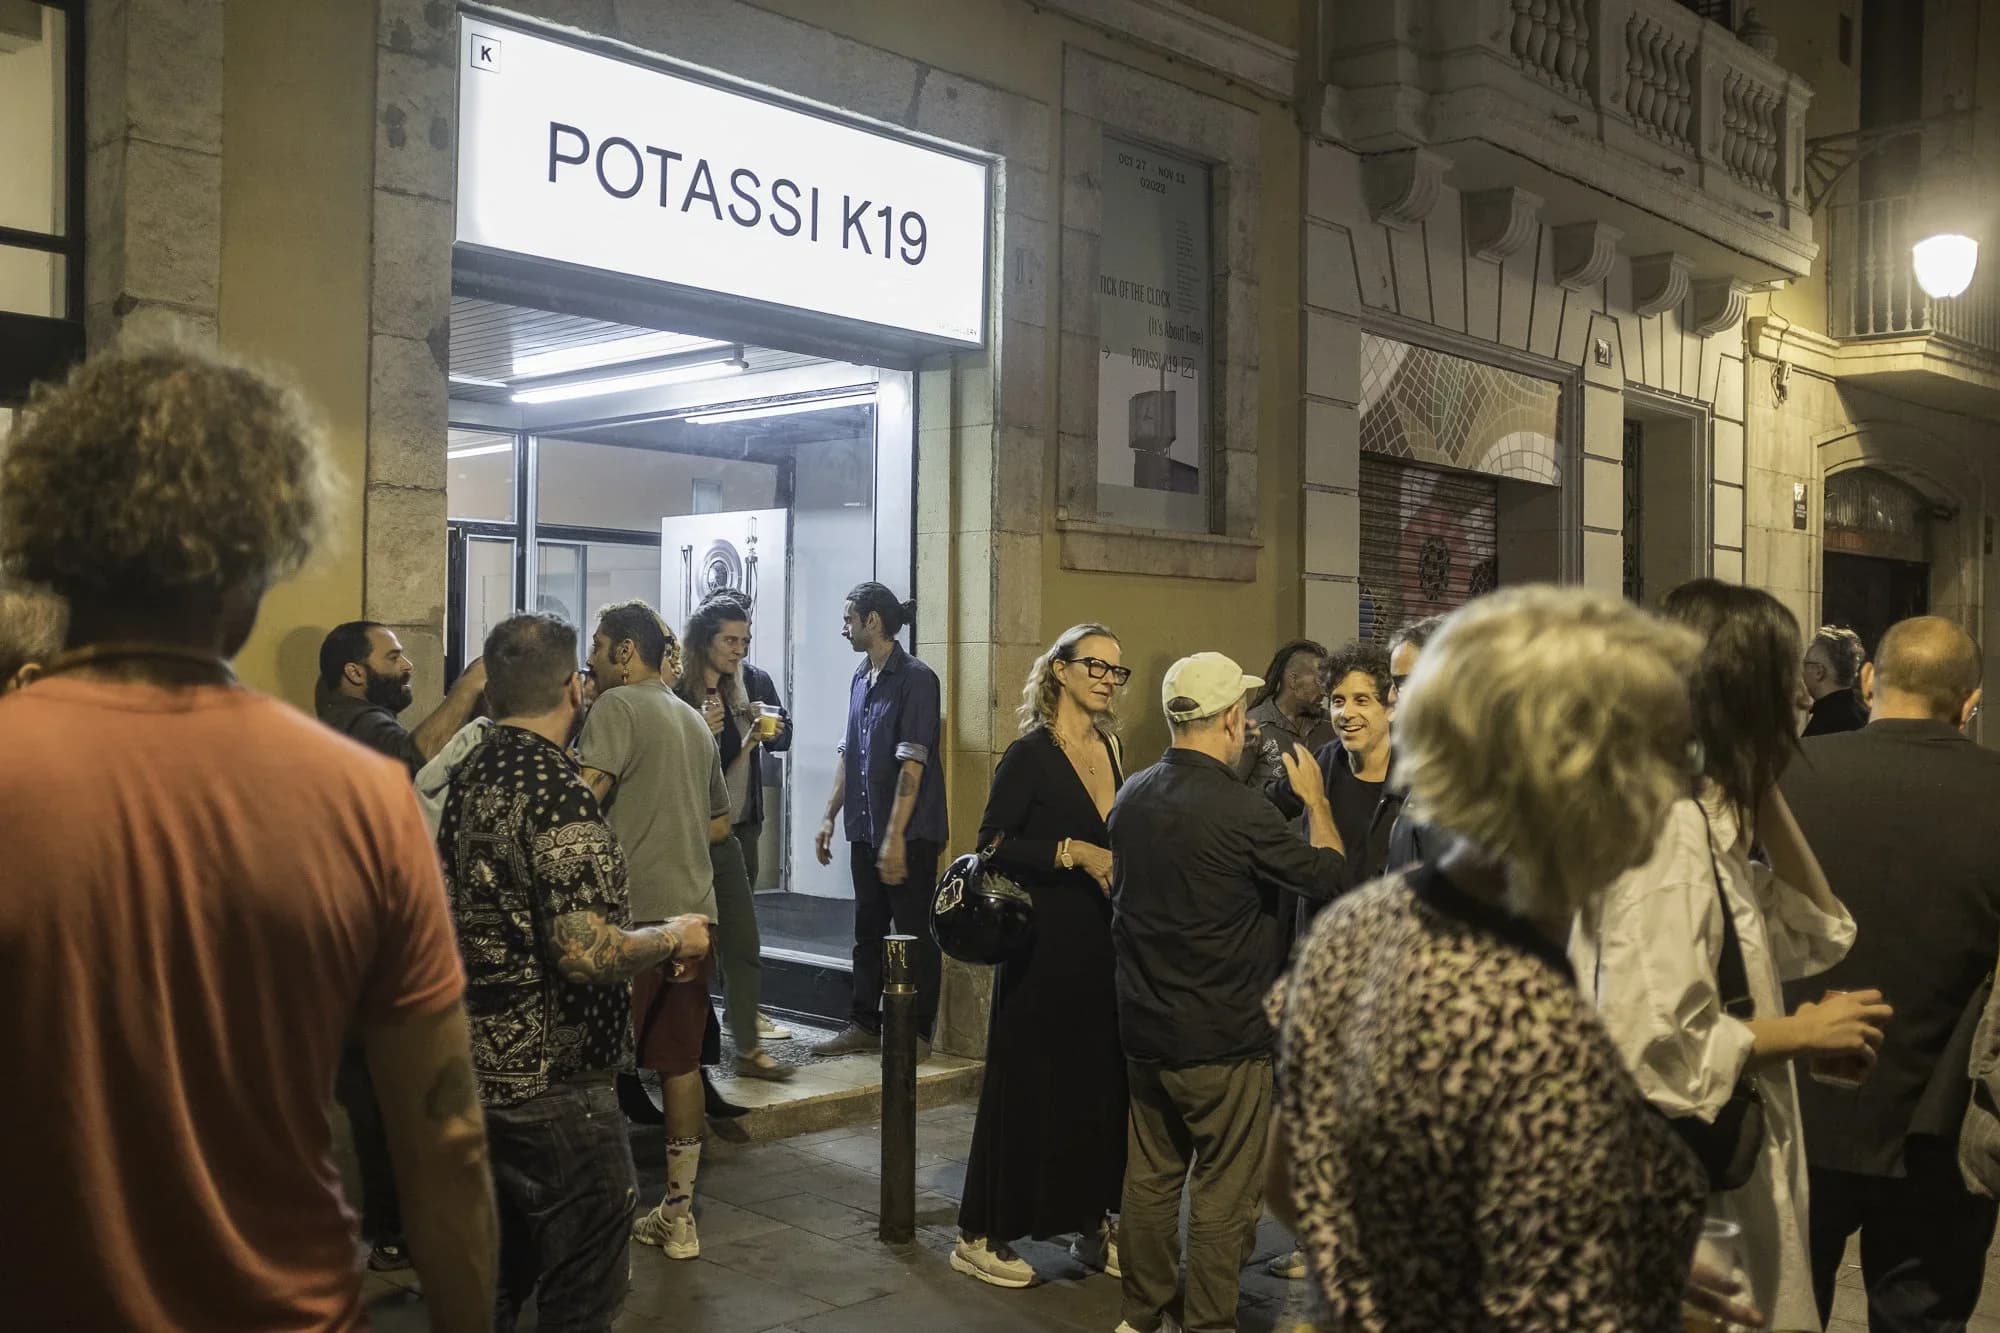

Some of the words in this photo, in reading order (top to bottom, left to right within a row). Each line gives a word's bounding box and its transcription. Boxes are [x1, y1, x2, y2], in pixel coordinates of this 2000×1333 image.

[481, 45, 492, 63] K
[1118, 153, 1133, 166] OCT
[1135, 159, 1146, 171] 27
[1158, 165, 1174, 181] NOV
[1175, 172, 1186, 184] 11
[548, 121, 818, 242] POTASSI
[842, 194, 928, 266] K19
[1119, 280, 1130, 299] OF
[1131, 282, 1145, 303] THE
[1146, 287, 1171, 309] CLOCK
[1165, 319, 1184, 342] About
[1131, 347, 1162, 370] POTASSI
